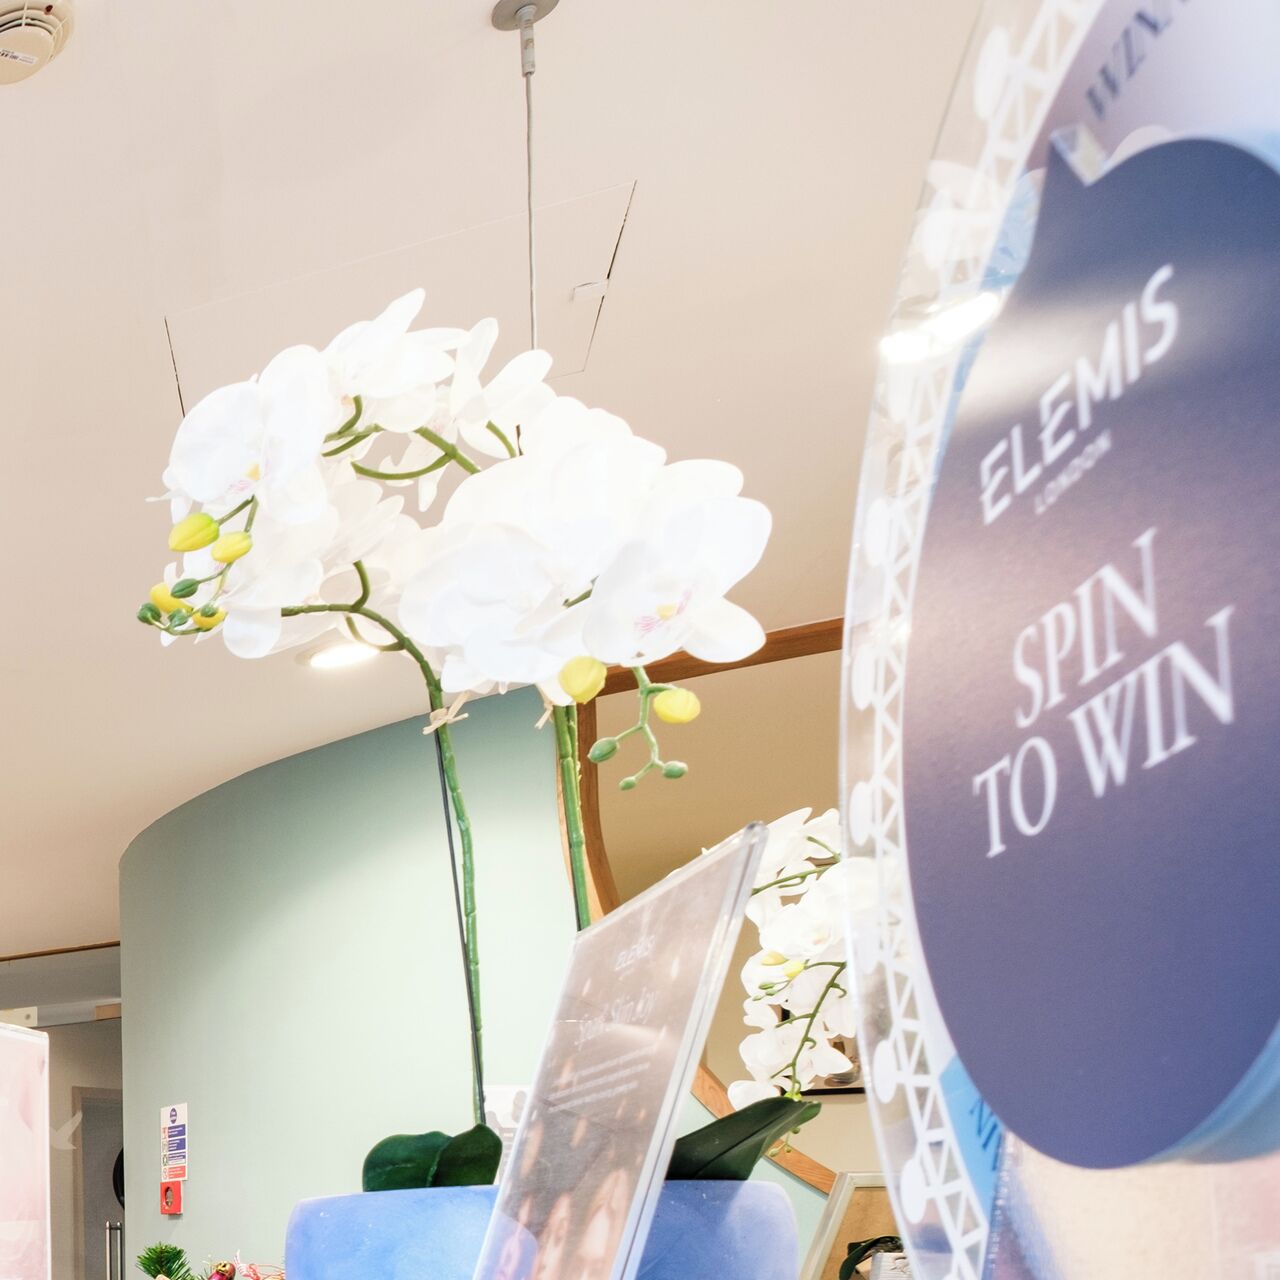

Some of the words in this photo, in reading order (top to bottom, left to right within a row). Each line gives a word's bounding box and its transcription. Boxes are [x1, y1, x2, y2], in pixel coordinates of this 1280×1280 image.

[980, 263, 1179, 526] ELEMIS
[1034, 428, 1113, 516] LONDON
[973, 735, 1058, 859] TO
[1067, 605, 1236, 798] WIN
[1013, 527, 1159, 728] SPIN
